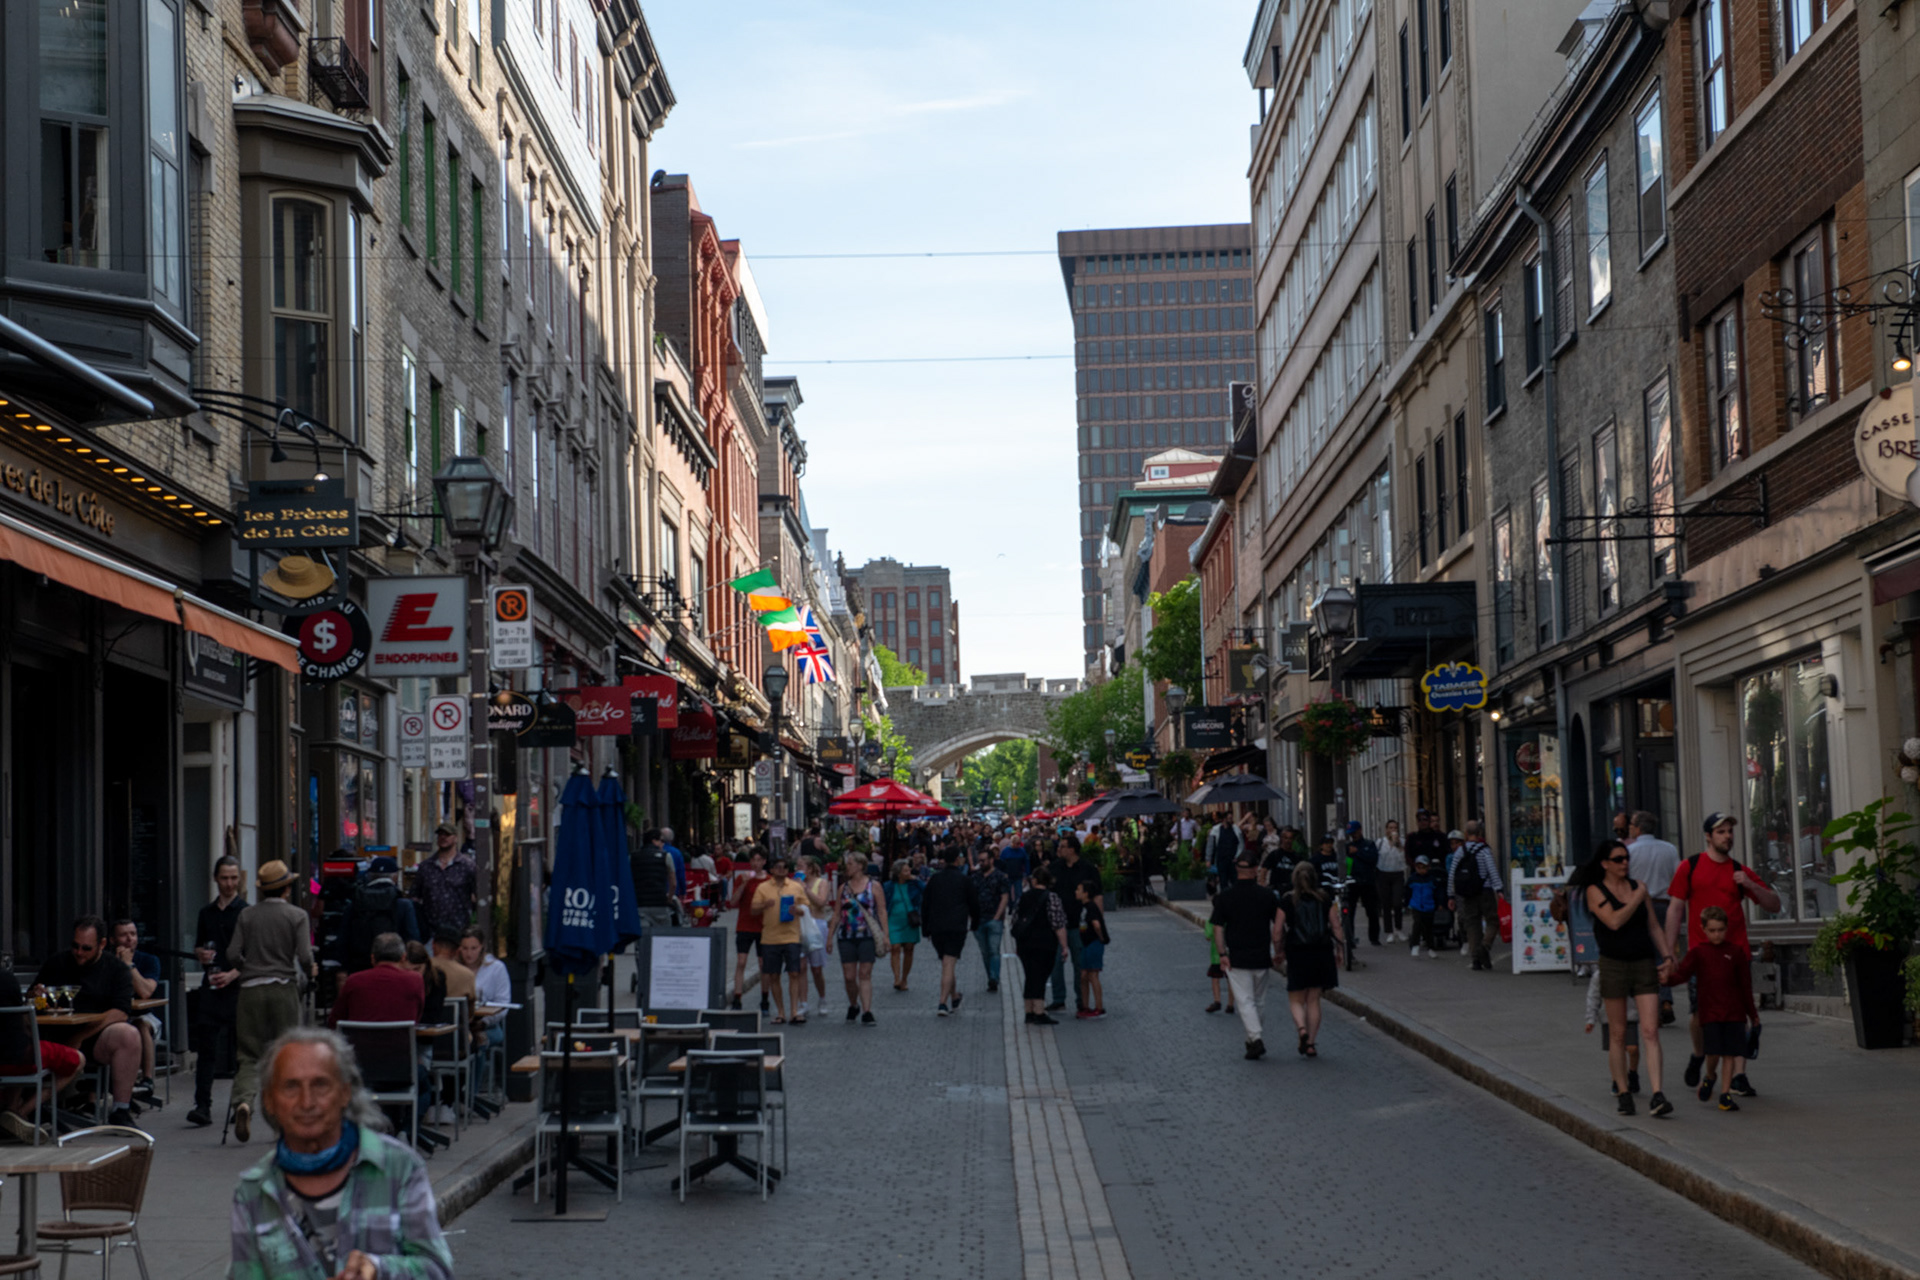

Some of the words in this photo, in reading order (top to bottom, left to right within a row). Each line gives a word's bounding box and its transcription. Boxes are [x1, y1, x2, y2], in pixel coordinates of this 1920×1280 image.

[28, 469, 53, 505] de
[54, 478, 73, 516] la
[75, 492, 115, 537] Côte
[243, 510, 275, 522] les
[279, 507, 349, 521] Frères
[242, 527, 270, 540] de
[274, 526, 295, 538] la
[300, 523, 350, 538] Côte
[305, 648, 365, 678] CHANGE
[375, 652, 459, 664] ENDORPHINES
